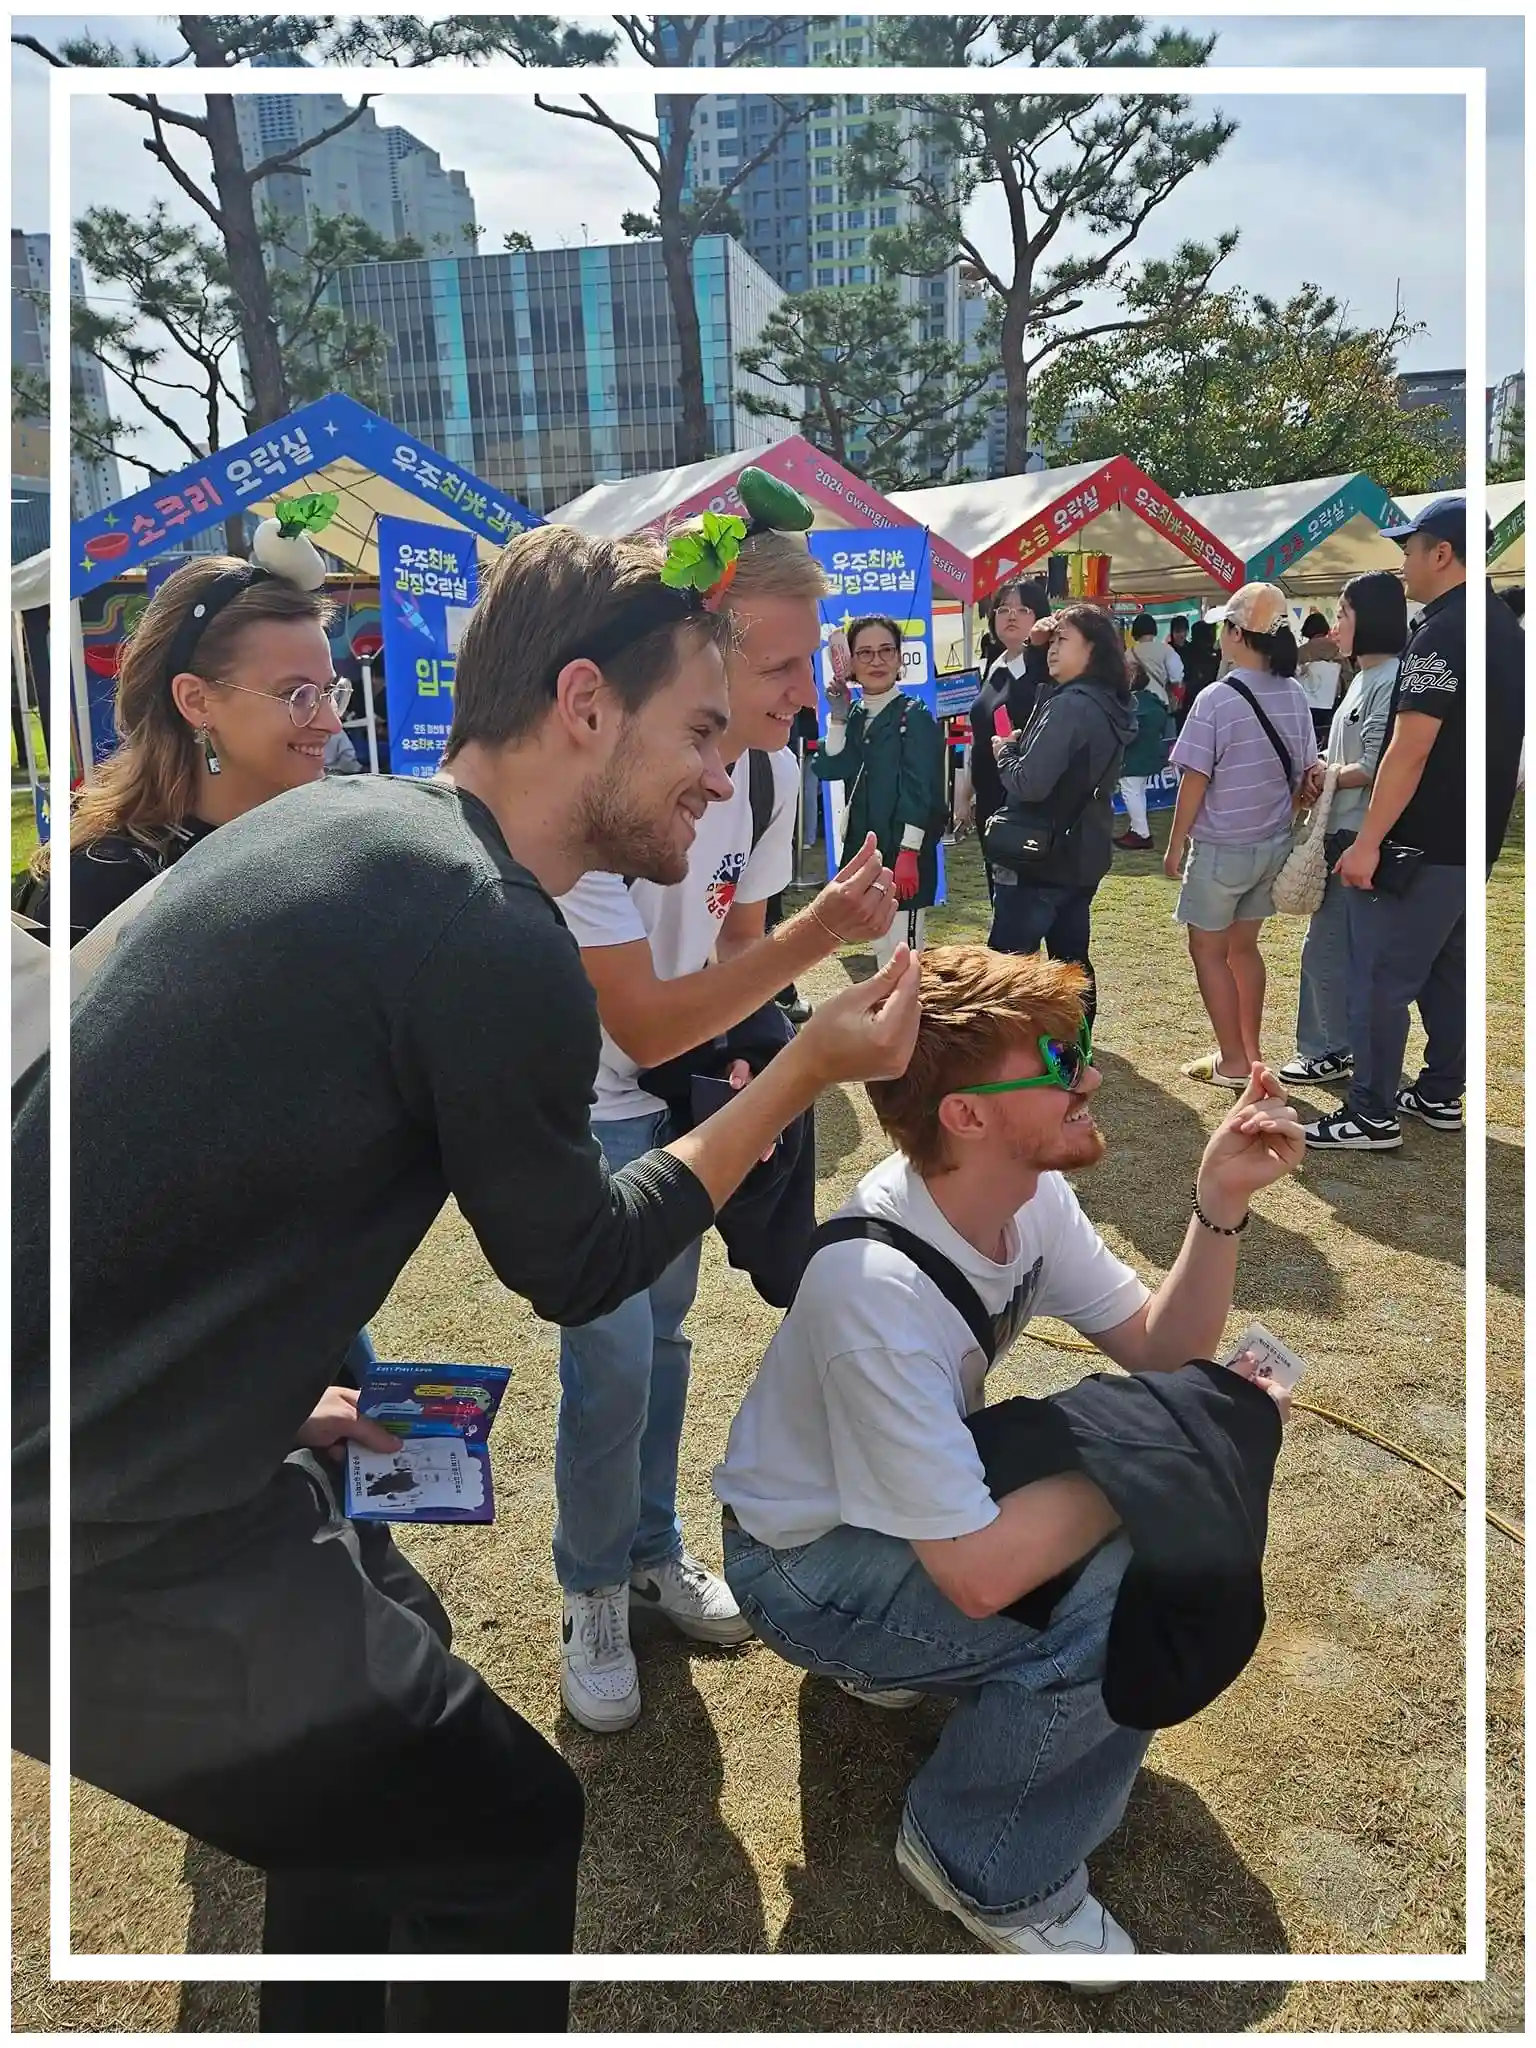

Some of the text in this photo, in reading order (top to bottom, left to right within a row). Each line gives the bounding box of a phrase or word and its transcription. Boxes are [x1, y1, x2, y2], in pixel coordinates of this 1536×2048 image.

[132, 426, 314, 547] 소쿠리 오락실
[815, 468, 844, 495] 2024
[1018, 485, 1099, 560] 소금 오락실
[1307, 498, 1345, 542] 오락실
[393, 567, 468, 601] 김장오락실
[828, 570, 915, 595] 김장오락실
